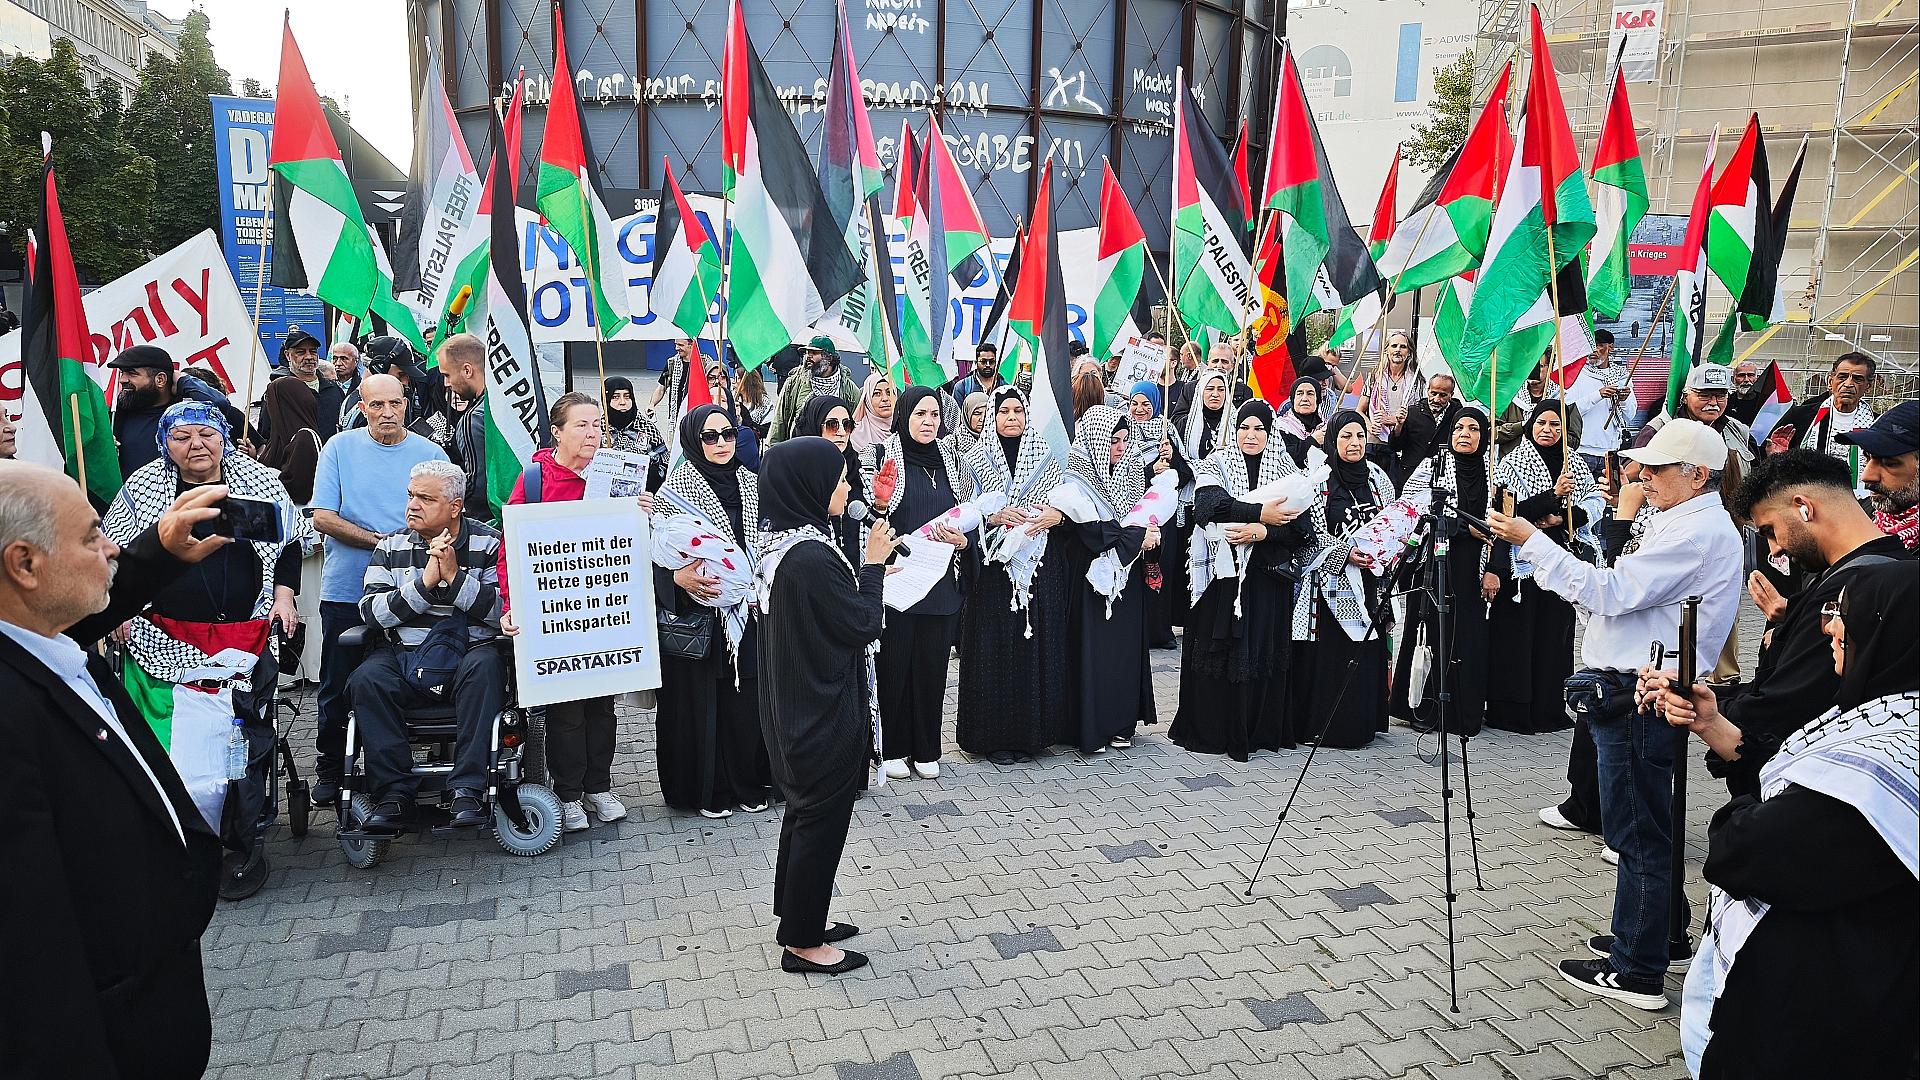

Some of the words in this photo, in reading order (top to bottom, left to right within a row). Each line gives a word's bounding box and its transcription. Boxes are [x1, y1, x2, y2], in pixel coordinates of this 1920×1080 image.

[1615, 10, 1656, 29] K&R
[1133, 68, 1173, 95] Macht
[1304, 65, 1340, 80] ETL
[1318, 111, 1351, 122] ETL.de
[232, 184, 274, 210] MA
[1637, 249, 1667, 261] Krieges
[1204, 233, 1261, 316] PALESTINE
[527, 541, 577, 557] Nieder
[582, 537, 606, 552] mit
[610, 535, 633, 550] der
[532, 553, 631, 574] zionistischen
[537, 575, 580, 591] Hetze
[585, 571, 630, 589] gegen
[541, 597, 582, 614] Linke
[586, 595, 600, 609] in
[605, 593, 629, 607] der
[541, 610, 631, 635] Linkspartei!
[536, 649, 643, 676] SPARTAKIST
